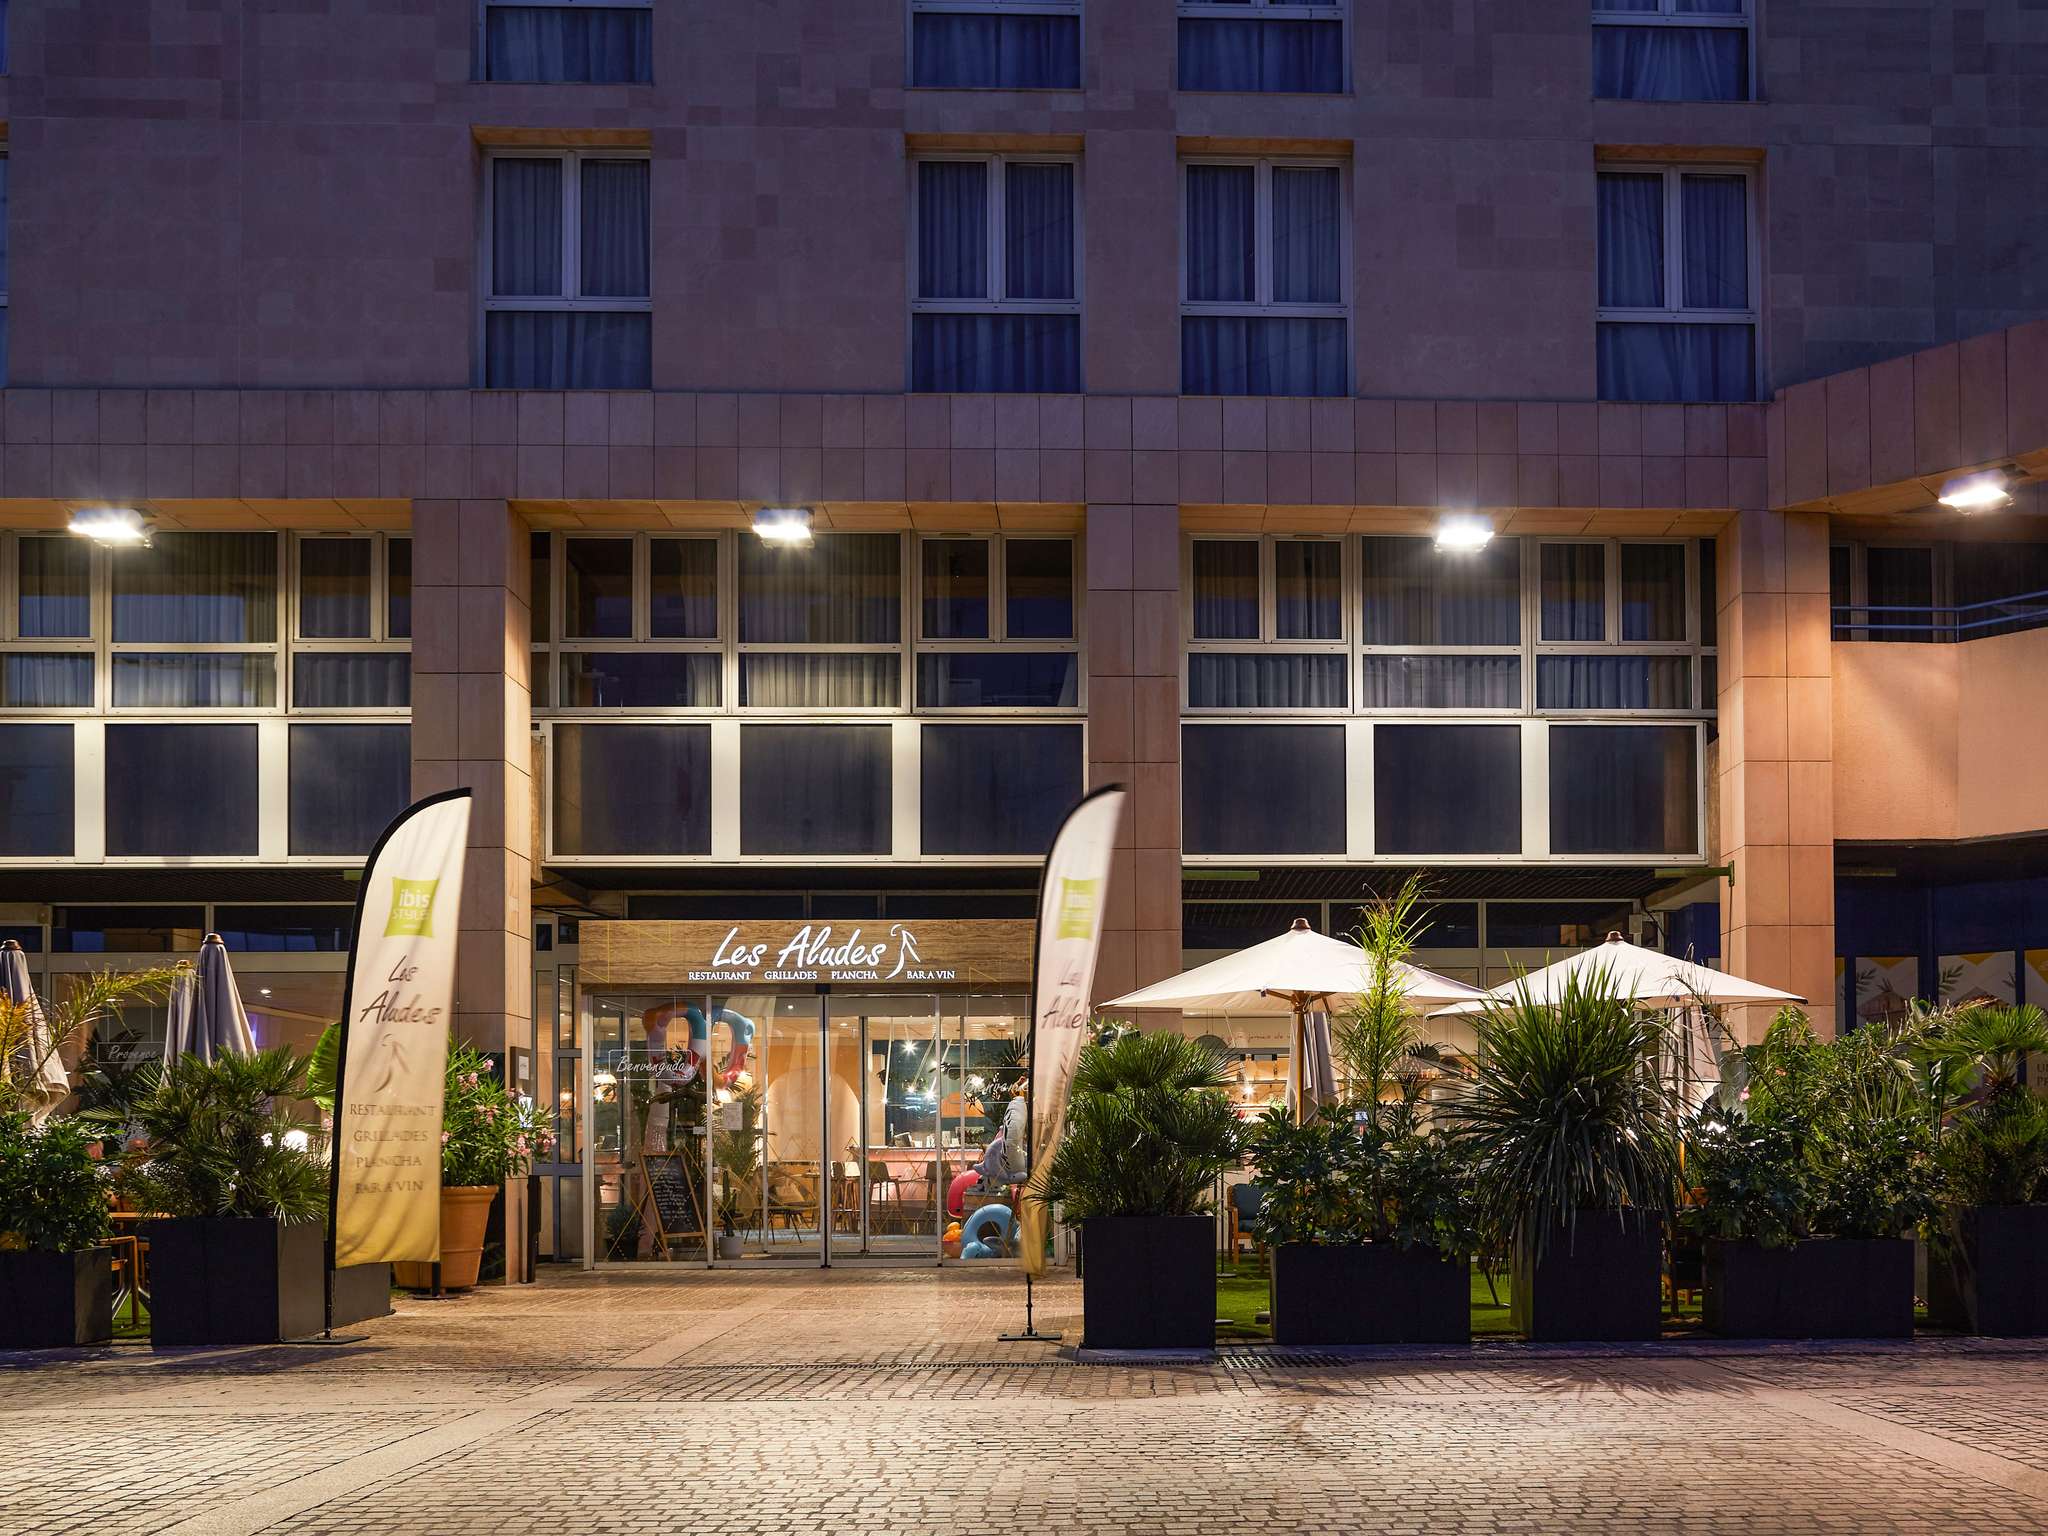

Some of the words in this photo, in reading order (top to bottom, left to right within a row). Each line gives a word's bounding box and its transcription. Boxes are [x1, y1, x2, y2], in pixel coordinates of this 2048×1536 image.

[399, 888, 431, 909] ibis
[712, 927, 768, 967] Les
[776, 925, 887, 969] Aludes
[388, 954, 418, 982] Les
[688, 971, 752, 980] RESTAURANT
[764, 970, 818, 980] GRILLADES
[831, 970, 878, 980] PLANCHA
[907, 970, 926, 979] BAR
[936, 970, 955, 979] VIN
[359, 990, 442, 1024] Aludes
[395, 1180, 424, 1192] VIN
